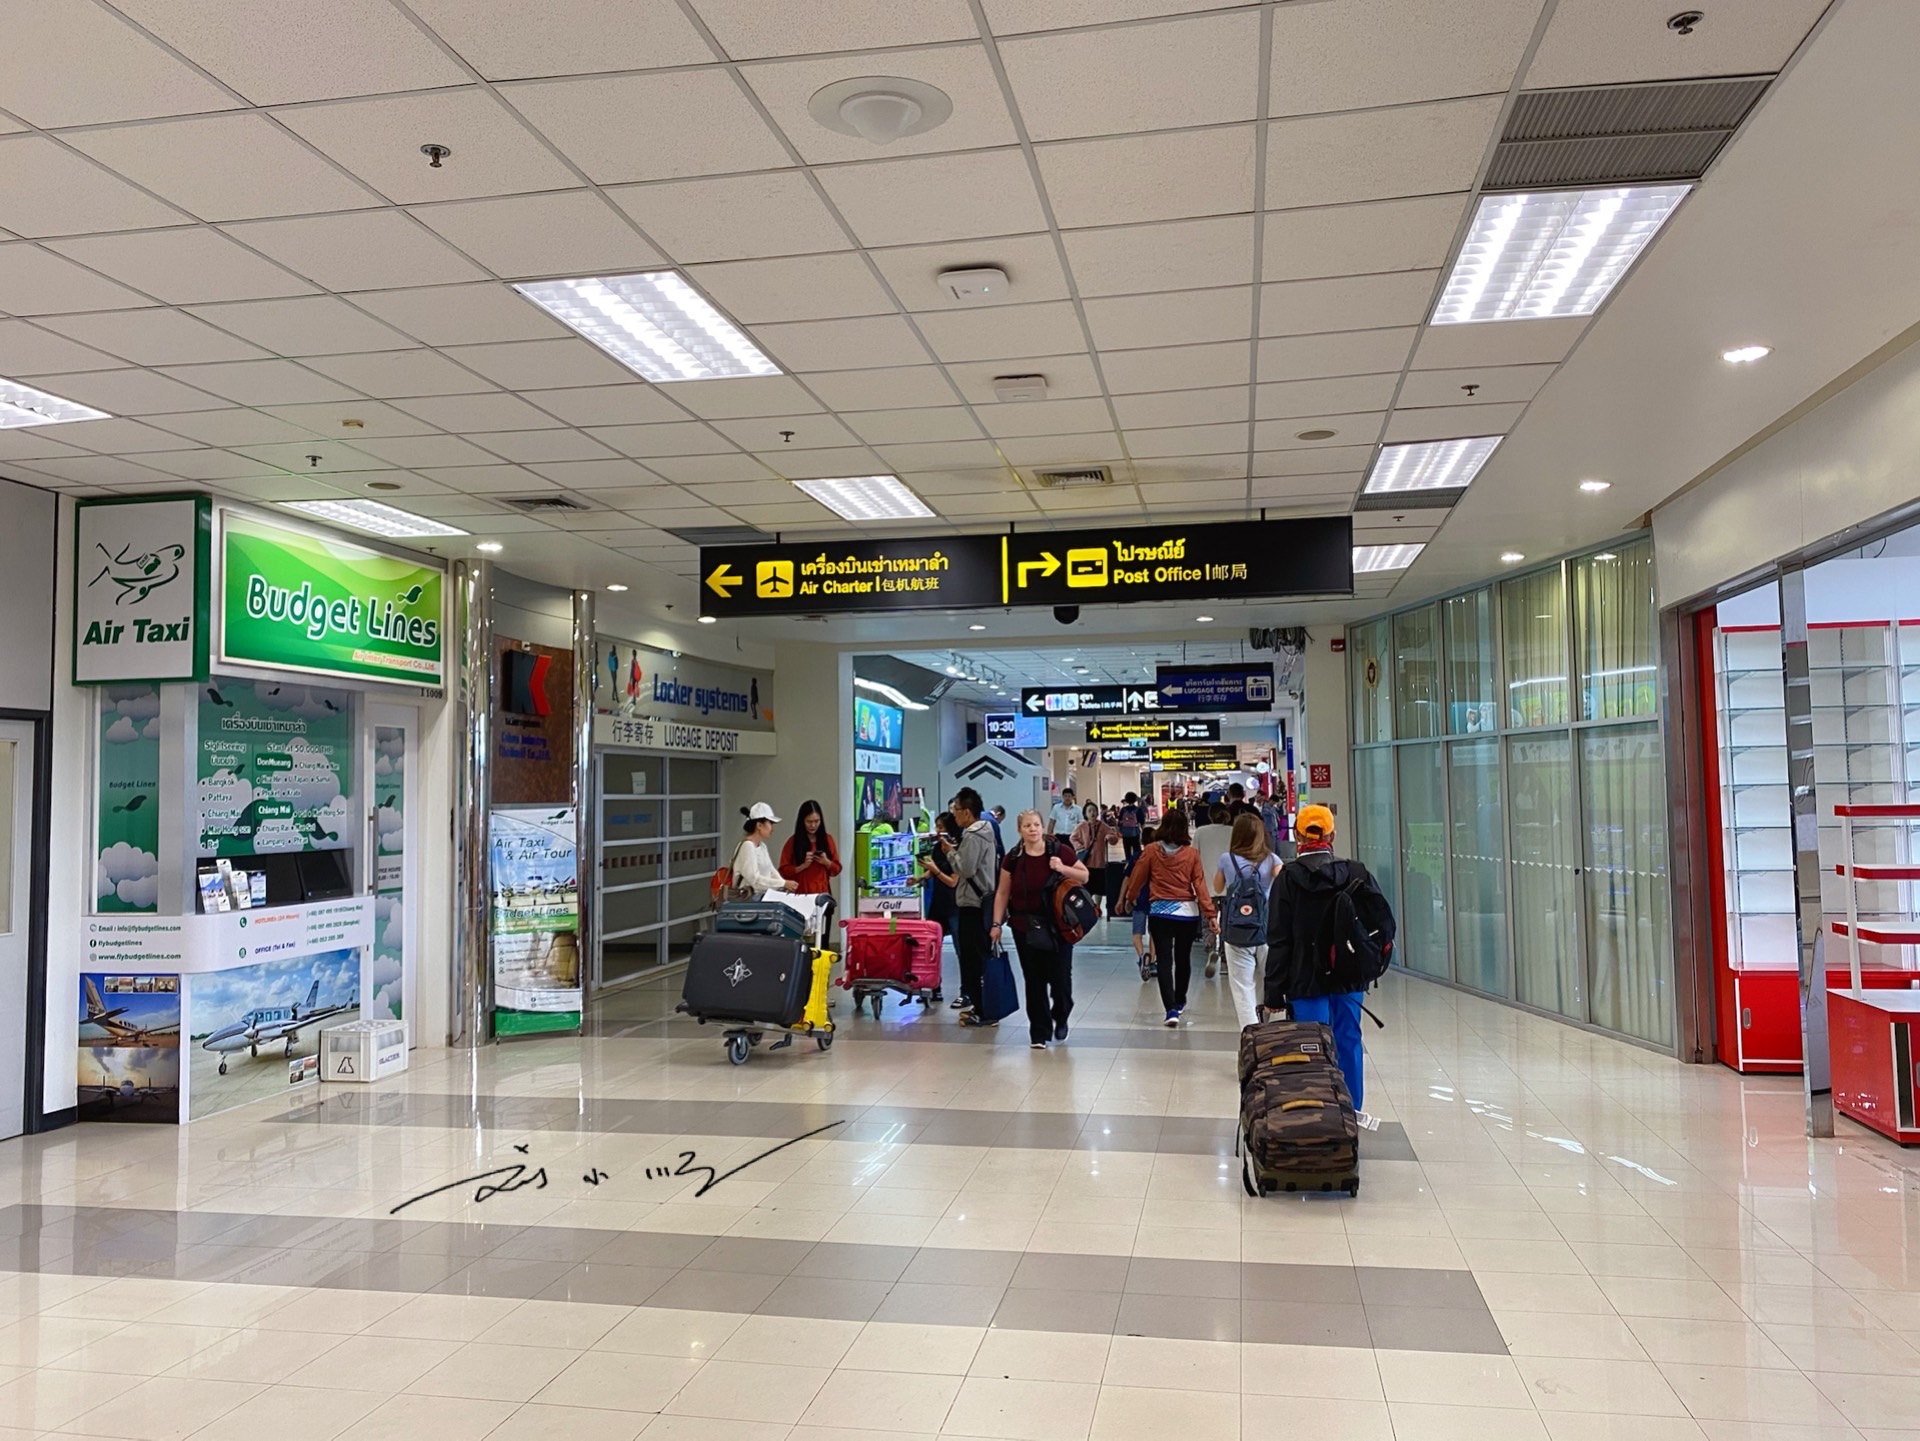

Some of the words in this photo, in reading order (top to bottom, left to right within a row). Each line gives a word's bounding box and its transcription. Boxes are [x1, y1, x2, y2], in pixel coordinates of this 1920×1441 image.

[1113, 538, 1187, 561] ไปรษณีย์
[801, 551, 949, 576] เครื่องบินเช่าเหมาลำ
[1114, 568, 1149, 584] Post
[1154, 566, 1202, 582] Office
[1212, 563, 1248, 581] 邮局
[799, 581, 817, 595] Air
[823, 579, 872, 594] Charter
[882, 576, 939, 593] 包机航班
[246, 574, 360, 641] Budget
[366, 596, 438, 648] Lines
[83, 621, 124, 646] Air
[132, 616, 190, 644] Taxi
[653, 672, 693, 706] Locker
[695, 684, 748, 716] systems
[1184, 686, 1215, 694] LUGGAGE
[1217, 686, 1243, 694] DEPOSIT
[612, 719, 654, 745] 行李寄存
[988, 721, 1014, 733] 10:30
[665, 724, 702, 749] LUGGAGE
[706, 730, 739, 752] DEPOSIT
[204, 741, 246, 754] Sightseeing
[257, 757, 291, 769] DonMueang
[109, 781, 135, 790] Budget
[136, 780, 156, 788] Lines
[208, 778, 235, 788] Bangkok
[208, 794, 232, 803] Pattaya
[208, 810, 228, 819] Chiang
[258, 805, 278, 815] Chiang
[280, 805, 291, 814] Mai
[222, 825, 239, 836] Hong
[495, 838, 513, 849] Air
[519, 836, 545, 849] Taxi
[505, 850, 514, 862] &
[518, 849, 538, 861] Air
[543, 848, 573, 860] Tour
[882, 901, 902, 910] Gulf
[495, 908, 535, 921] Budget
[539, 905, 569, 917] Lines
[117, 925, 181, 934] info@flybudgetlines.com
[255, 945, 272, 955] OFFICE
[98, 953, 181, 961] www.flybudgetlines.com
